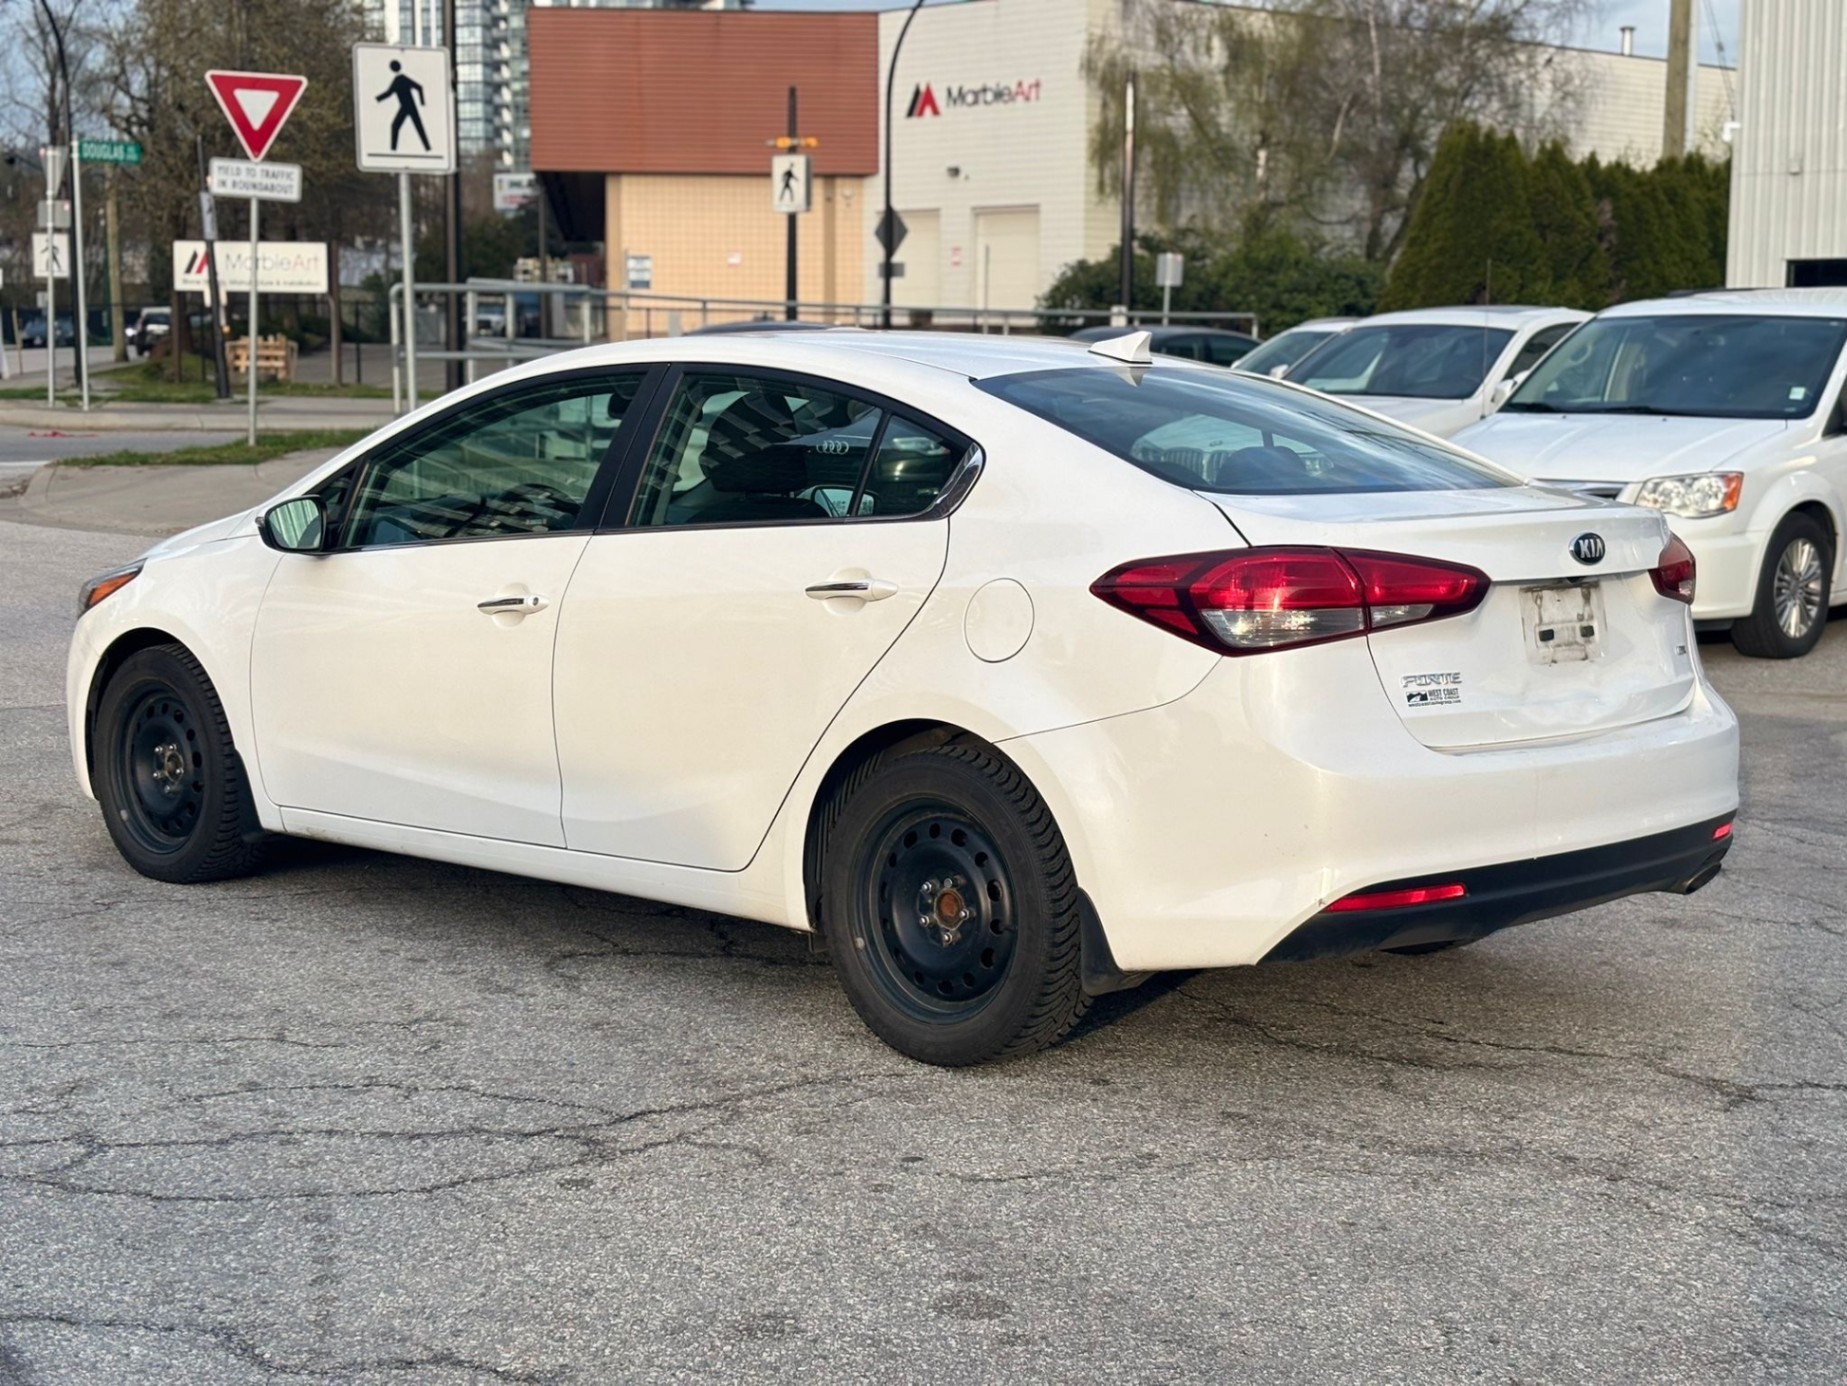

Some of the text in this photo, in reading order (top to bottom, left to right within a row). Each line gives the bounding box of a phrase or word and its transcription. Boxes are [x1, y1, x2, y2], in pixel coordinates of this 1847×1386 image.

[946, 78, 1041, 108] MarbleArt
[82, 143, 125, 160] DOUGLAS
[217, 165, 295, 181] YIELD TO TRAFFIC
[217, 179, 294, 194] IN ROUNDABOUT
[1579, 538, 1604, 558] KIA
[1401, 672, 1462, 688] FORTE
[1428, 688, 1459, 697] WEST COAST
